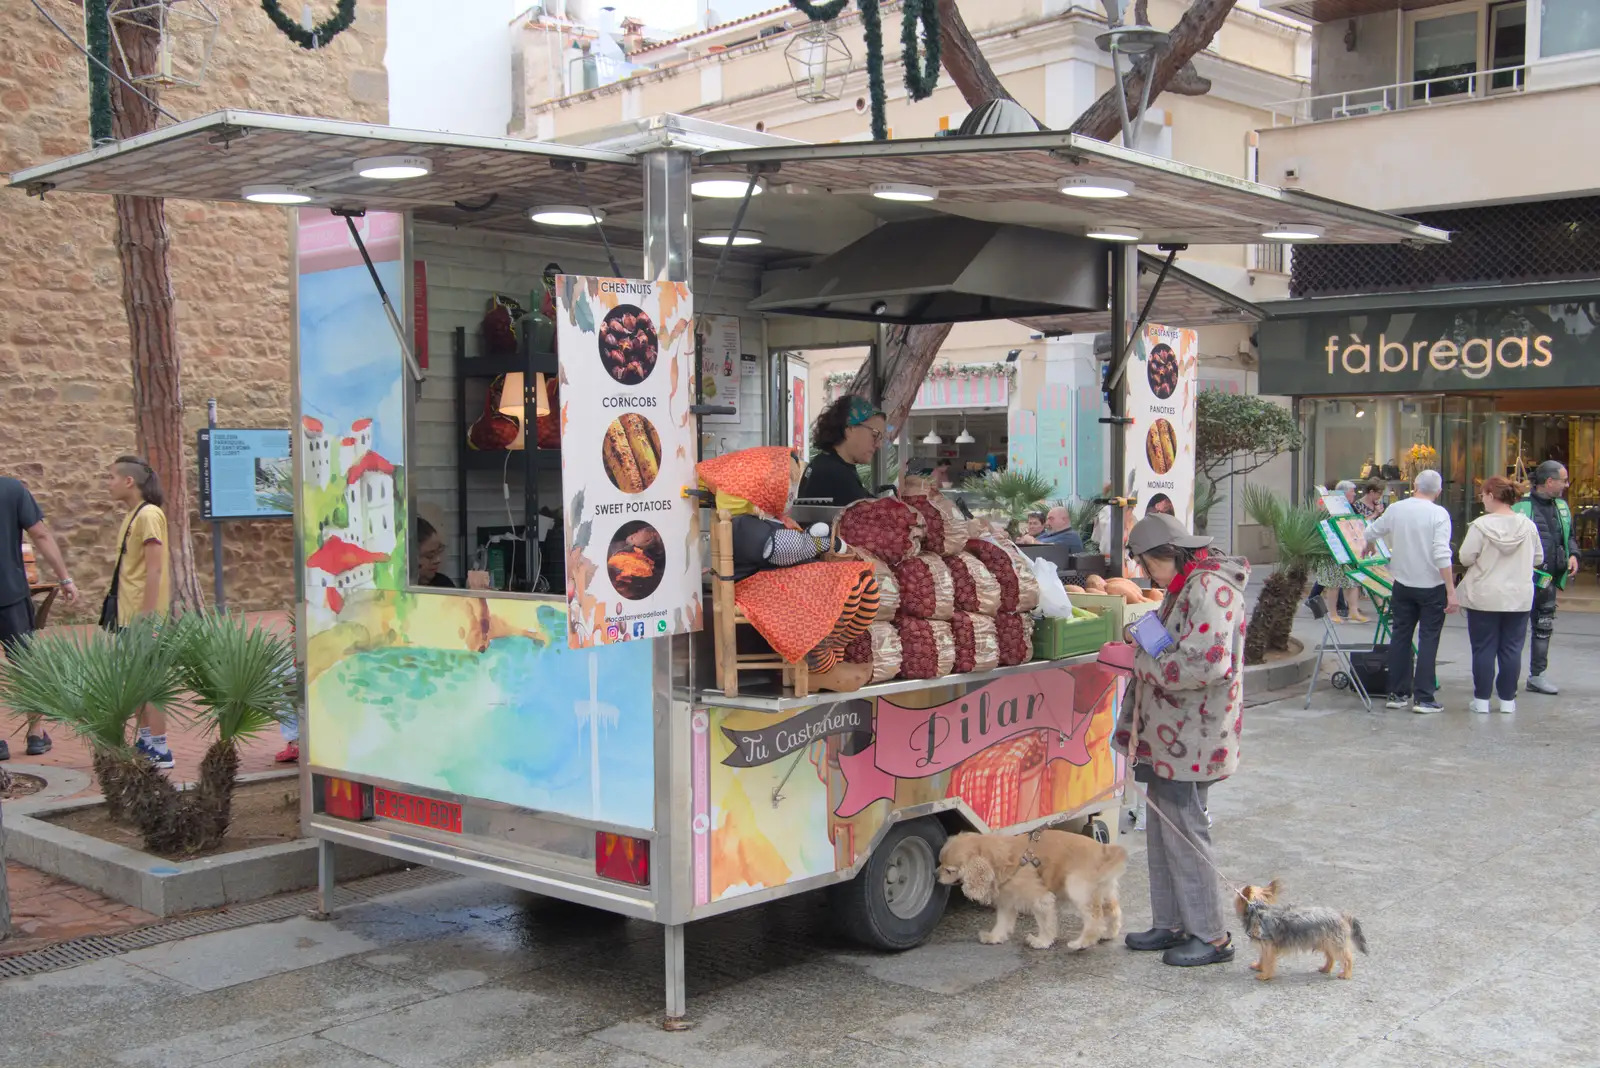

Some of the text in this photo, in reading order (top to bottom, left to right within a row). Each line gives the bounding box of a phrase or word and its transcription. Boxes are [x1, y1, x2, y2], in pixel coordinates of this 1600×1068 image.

[600, 281, 652, 295] CHESTNUTS
[1149, 327, 1179, 339] CASTANYES
[1324, 333, 1554, 380] fàbregas
[602, 396, 657, 408] CORNCOBS
[1147, 481, 1175, 489] MONIATOS
[595, 499, 672, 516] SWEET POTATOES
[908, 691, 1046, 769] Pilar
[742, 733, 769, 762] Tu
[390, 794, 427, 823] 9510
